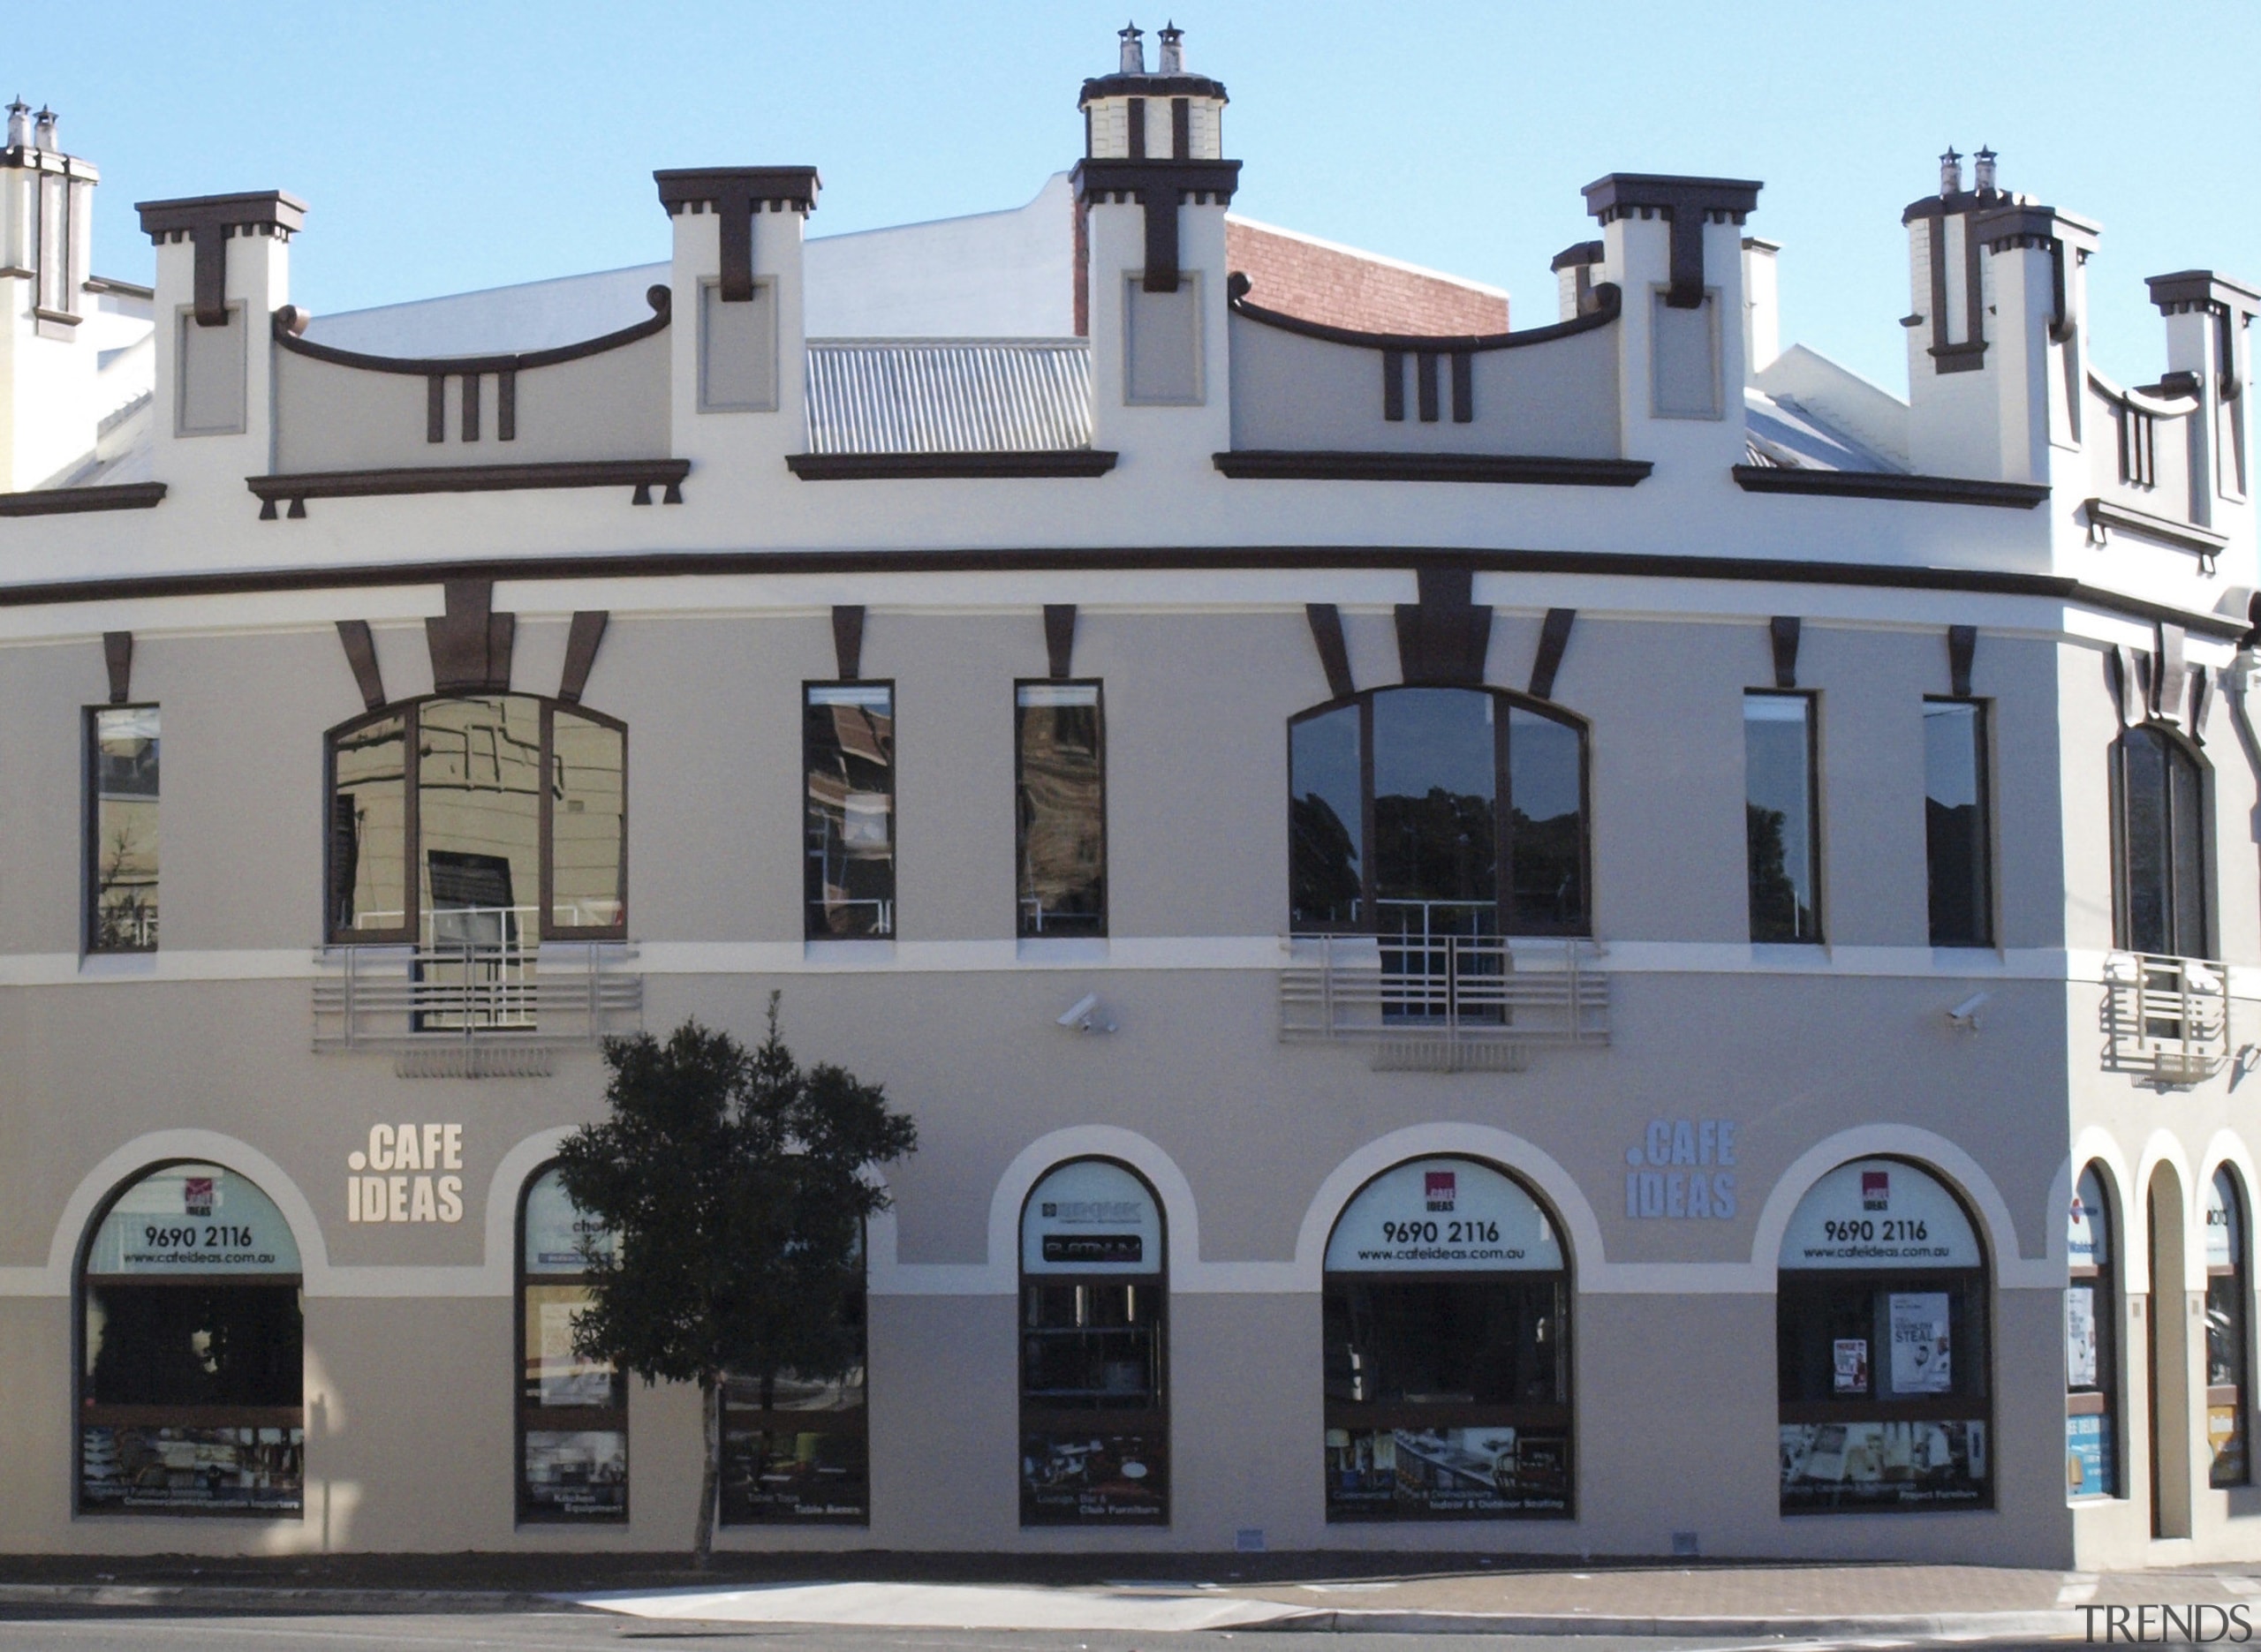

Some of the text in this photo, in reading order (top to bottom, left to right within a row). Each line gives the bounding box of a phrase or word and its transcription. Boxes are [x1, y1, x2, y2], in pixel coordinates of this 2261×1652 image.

[348, 1175, 464, 1223] IDEAS
[1626, 1171, 1737, 1219] IDEAS
[1426, 1201, 1455, 1212] IDEAS
[1864, 1200, 1888, 1211] IDEAS
[146, 1226, 253, 1248] 9690 2116
[1383, 1221, 1500, 1243] 9690 2116
[1825, 1220, 1927, 1241] 9690 2116
[124, 1251, 276, 1264] www.cafeideas.com.au
[1357, 1247, 1525, 1260] www.cafeideas.com.au
[1804, 1245, 1949, 1258] www.cafeideas.com.au
